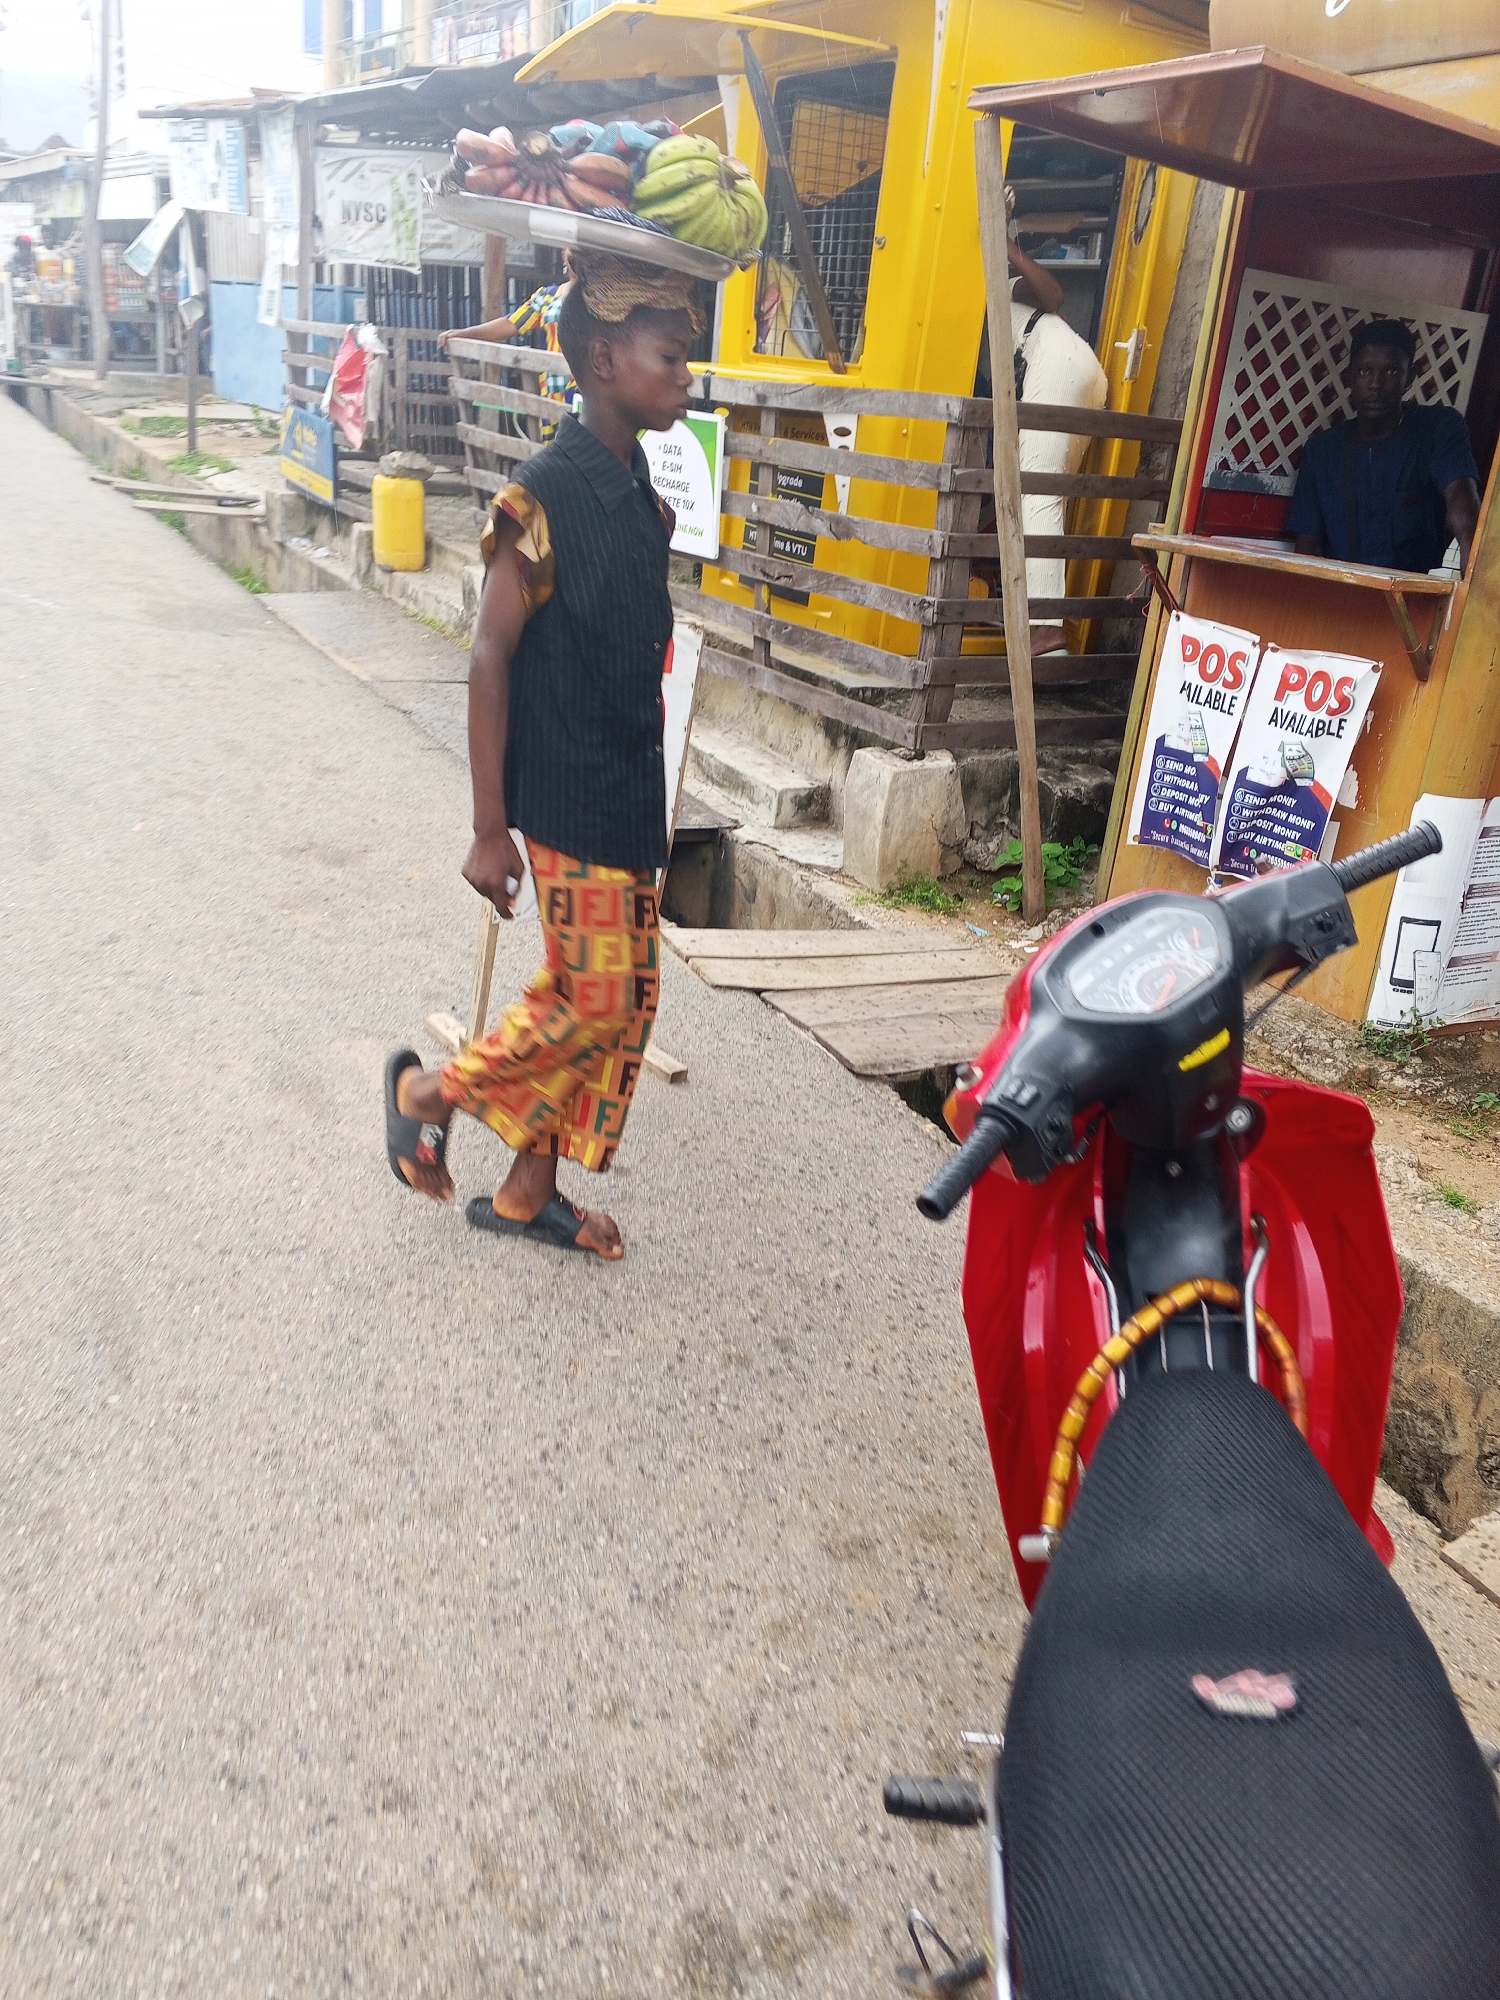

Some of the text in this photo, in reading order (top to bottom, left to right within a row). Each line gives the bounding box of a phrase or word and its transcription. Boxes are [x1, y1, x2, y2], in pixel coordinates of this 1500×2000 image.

[341, 201, 387, 223] NYSC
[790, 427, 826, 442] Services
[662, 443, 683, 457] DATA
[652, 475, 691, 493] RECHARGE
[689, 525, 705, 538] NOW
[792, 542, 808, 557] VTU
[1181, 634, 1248, 690] POS
[1273, 662, 1356, 717] POS
[1268, 706, 1348, 740] AVAILABLE
[1165, 759, 1184, 772] SEND
[1160, 787, 1189, 803] DEPOSIT
[1243, 793, 1298, 808] SEND MONEY
[1158, 801, 1175, 813] BUY
[1242, 806, 1316, 831] WITHDRAW MONEY
[1239, 818, 1302, 841] DEPOSIT MONEY
[1237, 831, 1256, 841] BUY
[1254, 834, 1286, 852] AIRTIME
